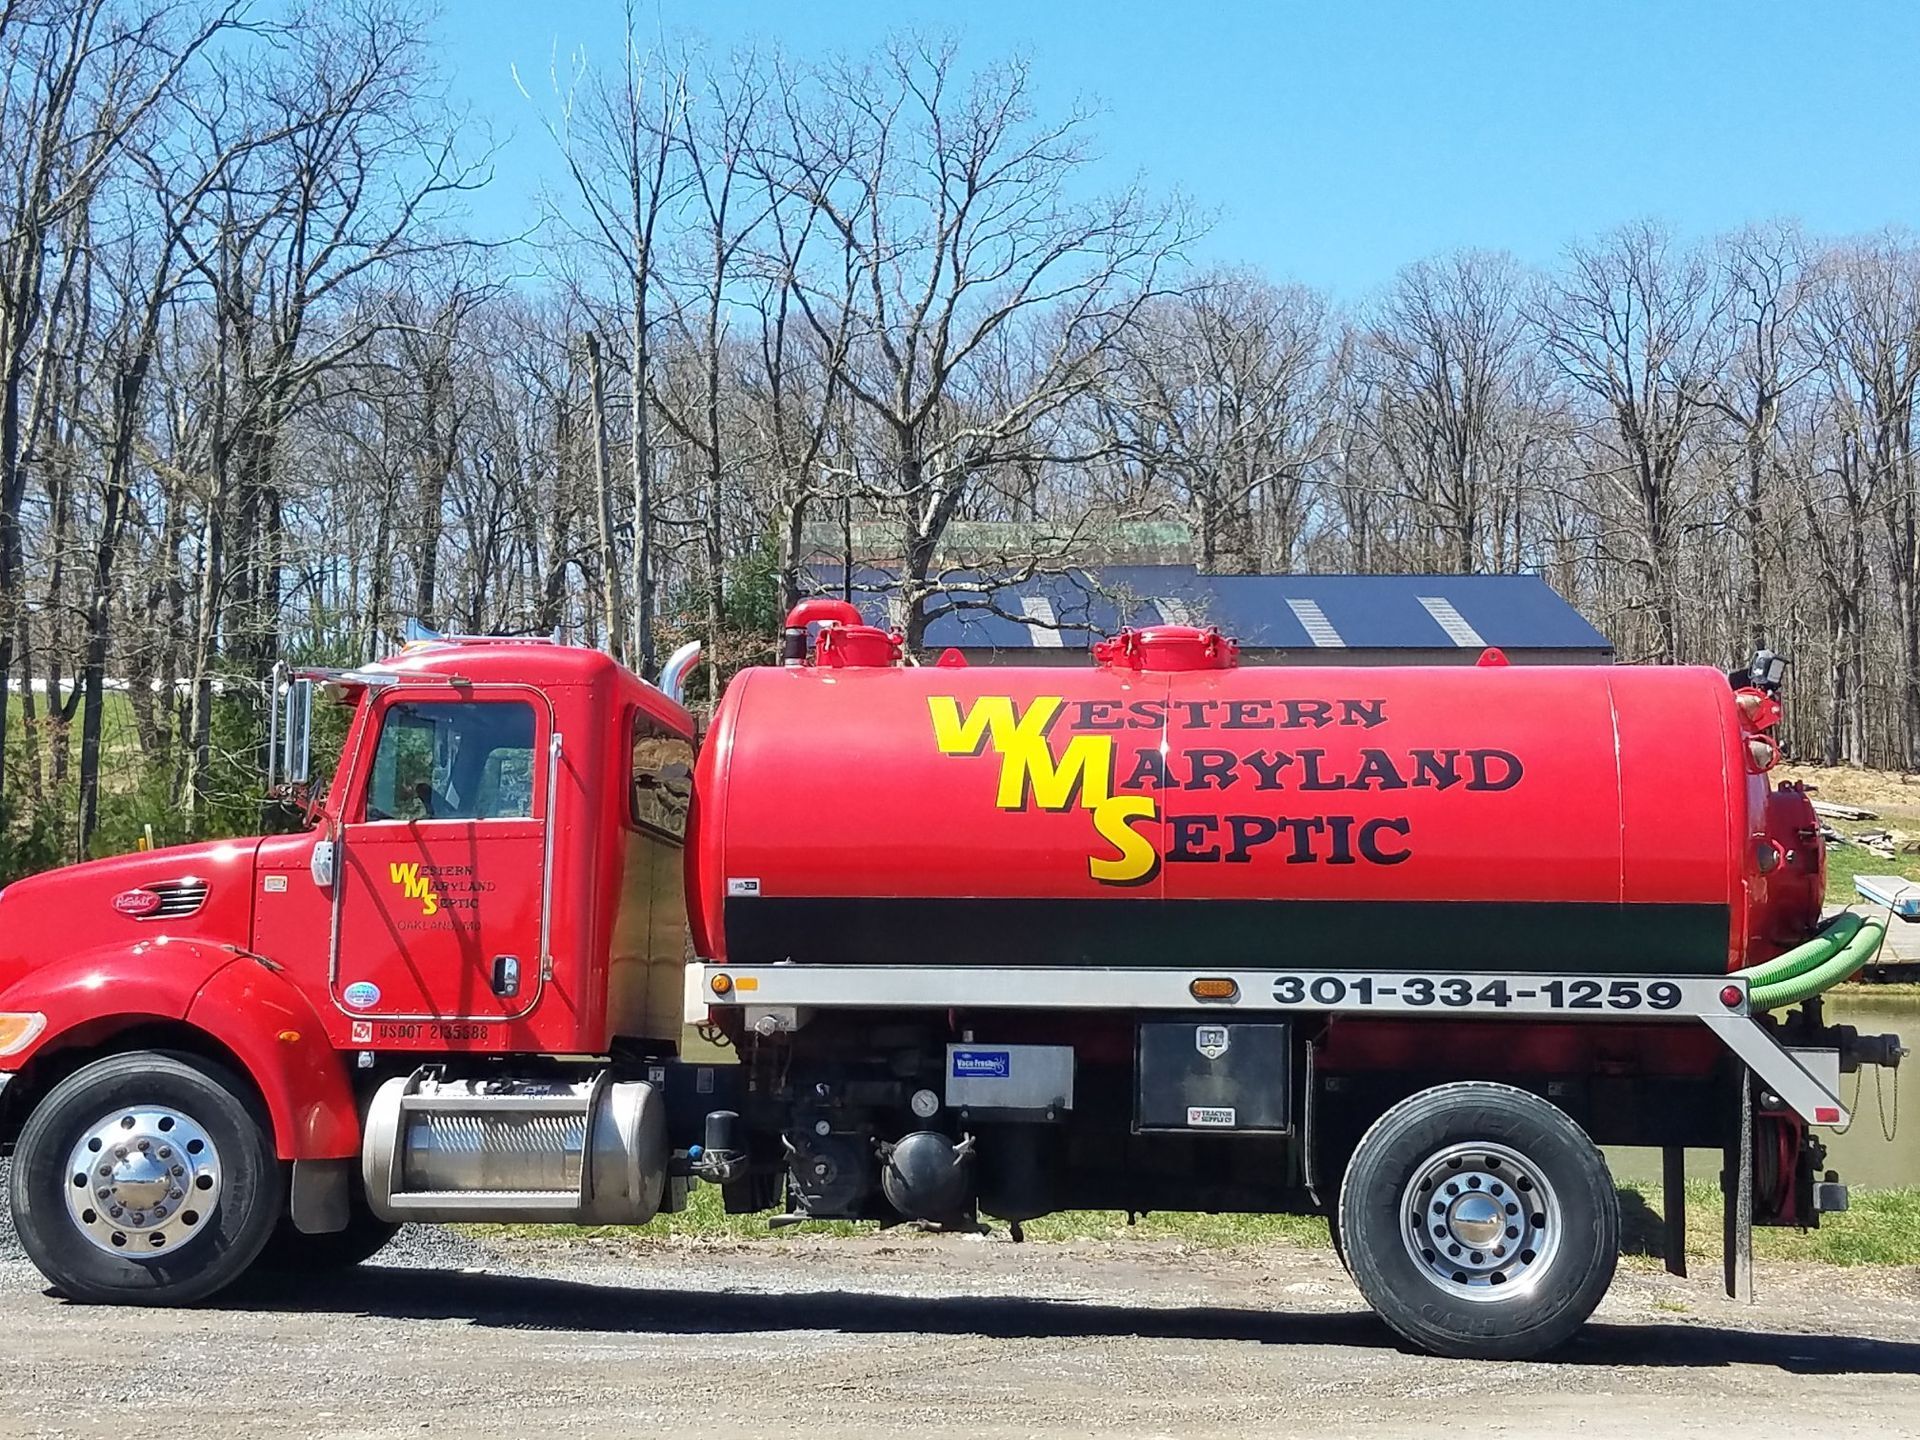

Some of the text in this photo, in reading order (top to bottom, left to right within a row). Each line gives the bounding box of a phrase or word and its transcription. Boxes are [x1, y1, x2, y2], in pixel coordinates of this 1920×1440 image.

[927, 696, 1388, 757] WESTERN
[996, 735, 1523, 812] MARYLAND
[1088, 796, 1412, 887] SEPTIC
[389, 863, 474, 884] WESTERN
[404, 877, 496, 898] MARYLAND
[422, 894, 479, 915] SEPTIC
[1272, 976, 1683, 1010] 301-334-1259
[379, 1025, 423, 1039] USDOT
